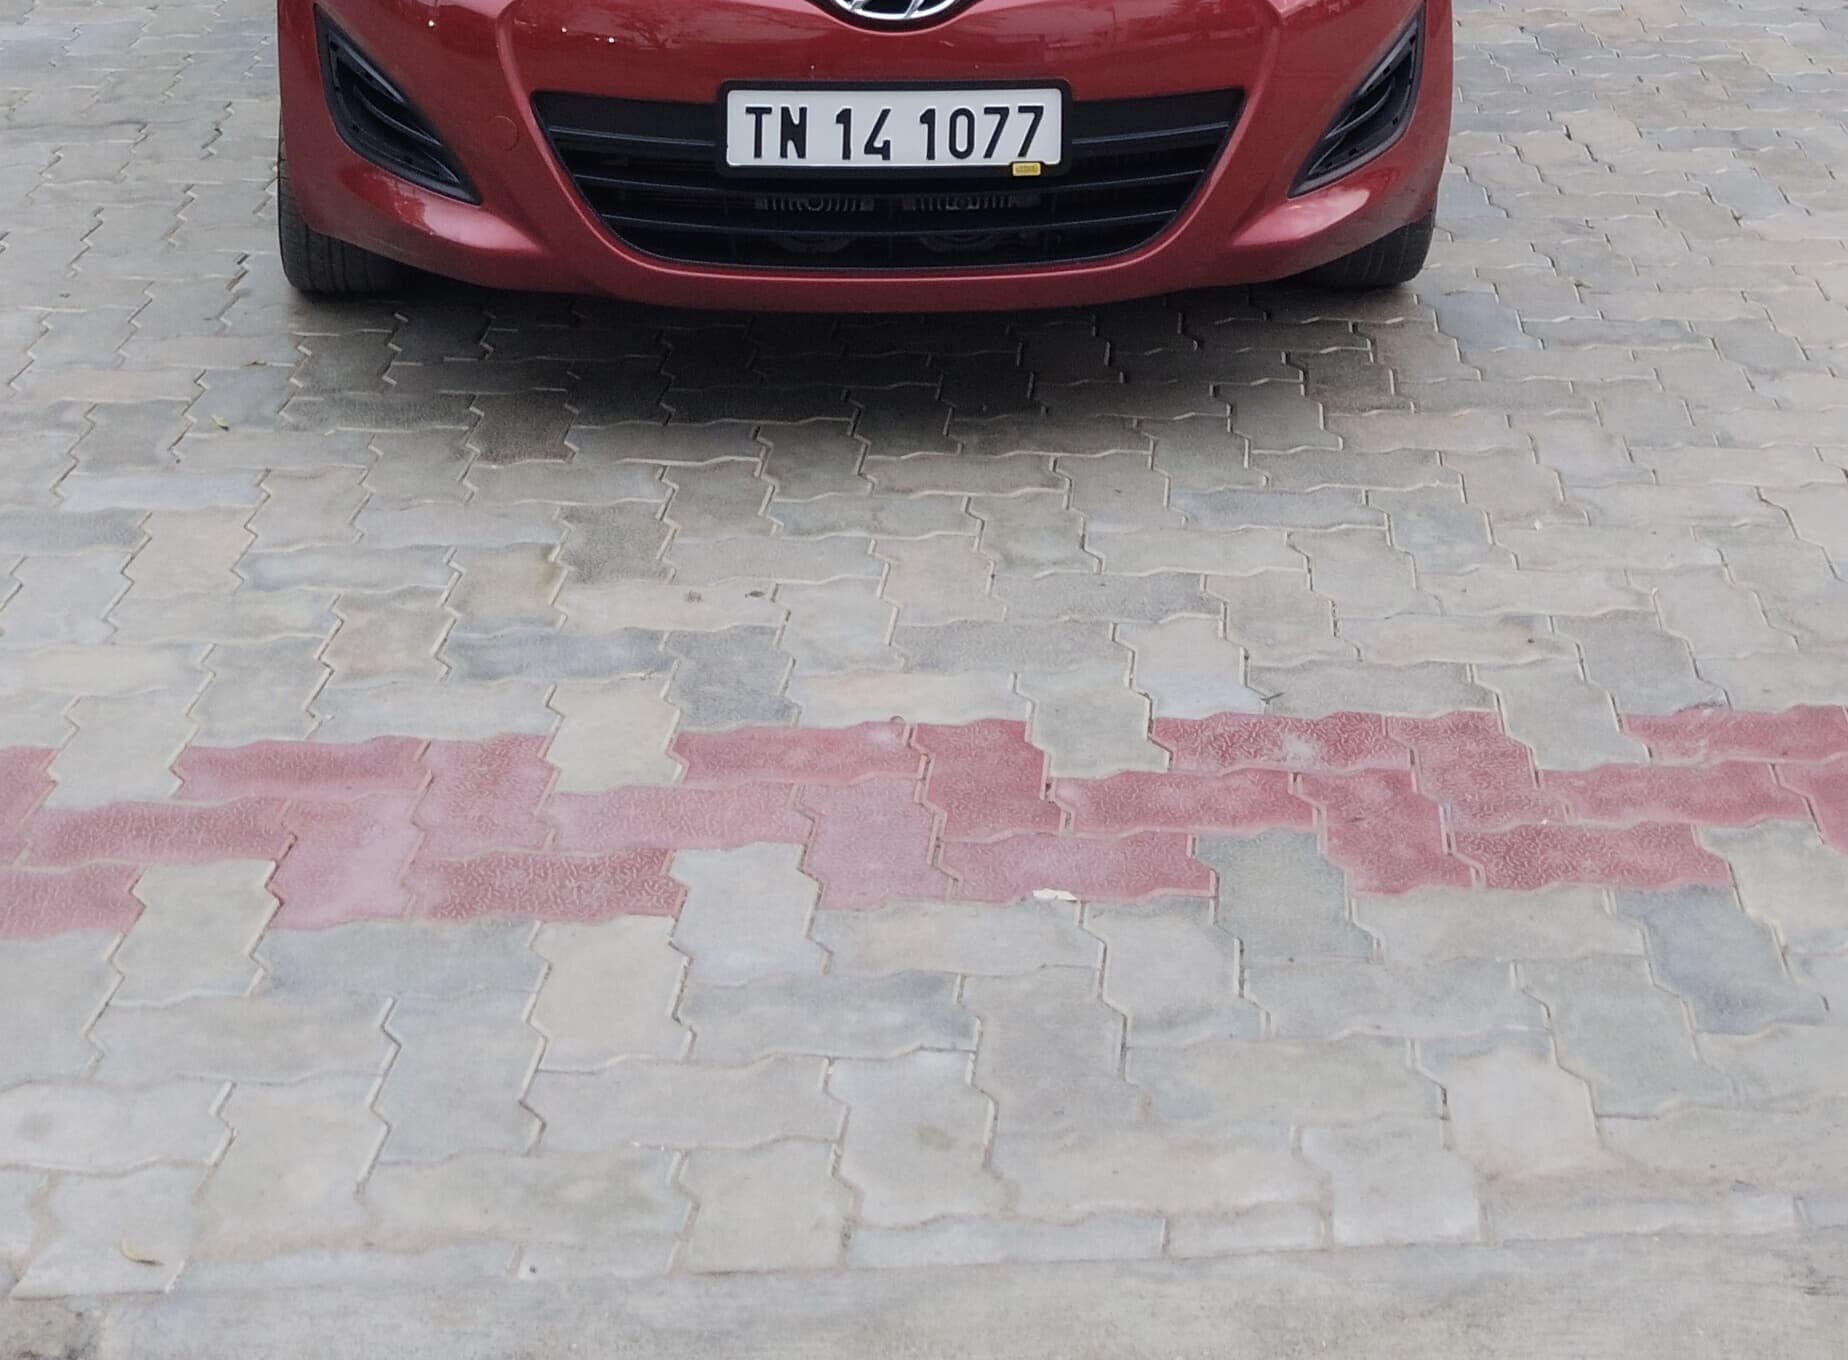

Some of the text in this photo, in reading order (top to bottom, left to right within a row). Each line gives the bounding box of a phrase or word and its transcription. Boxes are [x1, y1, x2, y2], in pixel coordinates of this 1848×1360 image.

[745, 105, 1045, 161] TN 14 1077
